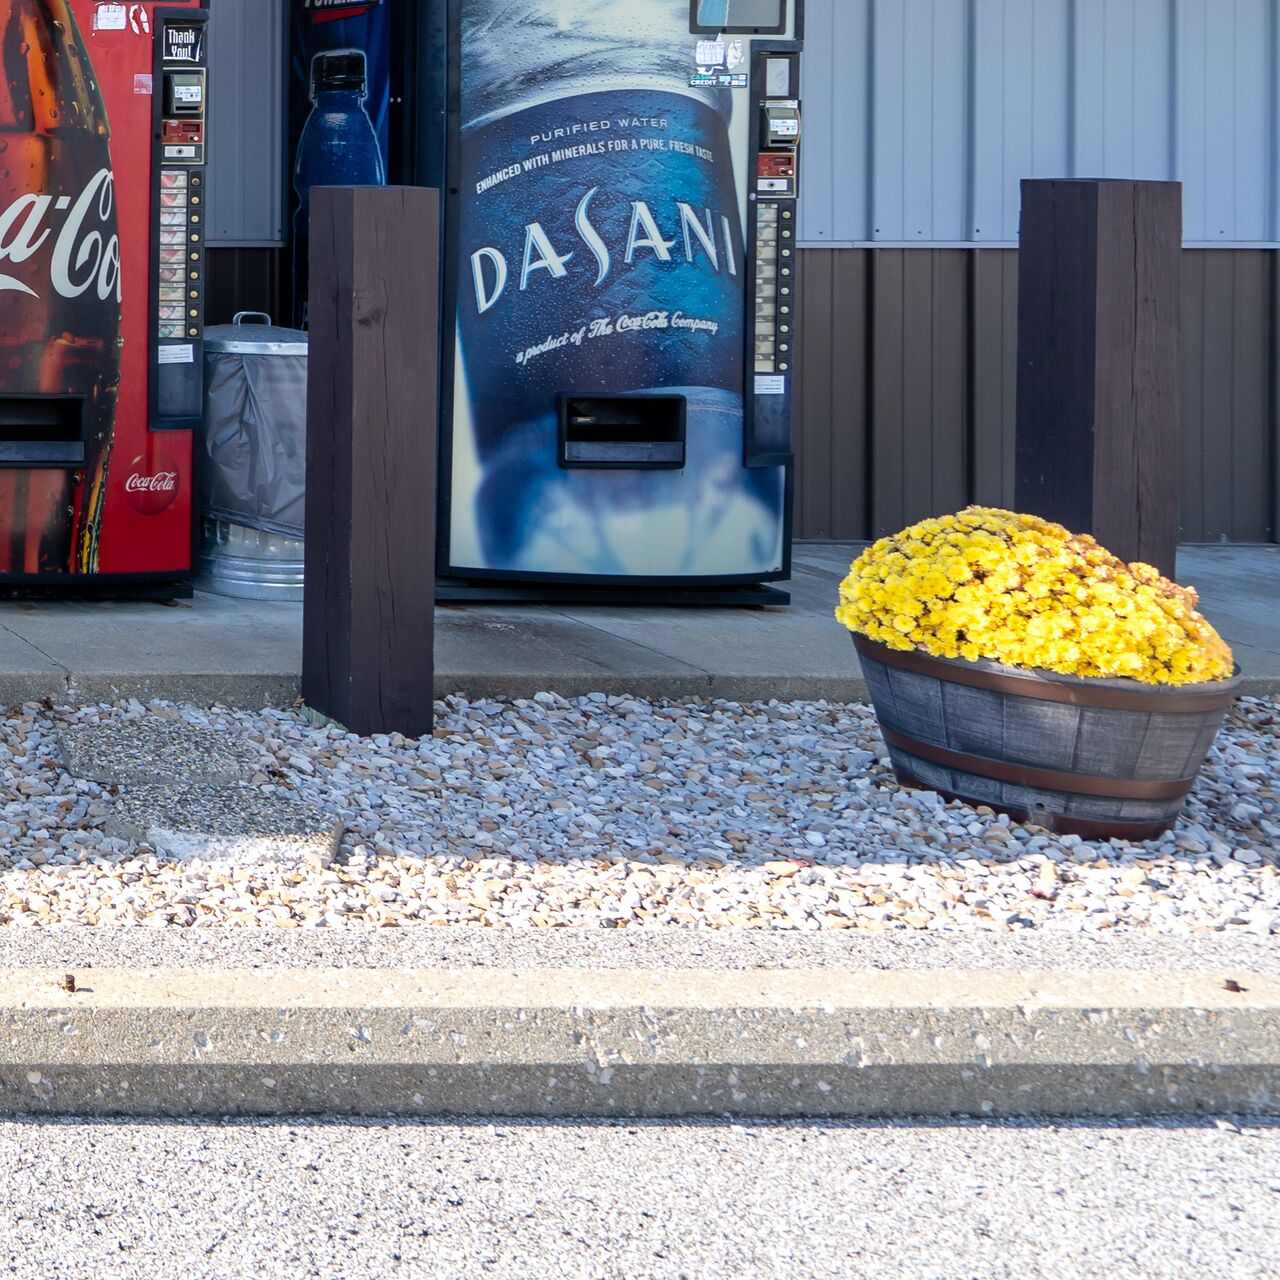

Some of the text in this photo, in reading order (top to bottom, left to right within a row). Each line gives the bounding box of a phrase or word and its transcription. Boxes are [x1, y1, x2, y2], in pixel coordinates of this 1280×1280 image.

[168, 29, 195, 44] Thank
[171, 45, 191, 58] You!
[530, 118, 668, 145] PURIFIED WATER
[476, 163, 522, 195] ENHANCED
[523, 154, 550, 172] WITH
[552, 140, 606, 163] MINERALS
[608, 140, 628, 152] FOR
[631, 139, 639, 150] A
[669, 140, 695, 155] FRESH
[470, 186, 736, 314] DASANI
[516, 311, 719, 365] a product of The Coca-Cola Company
[126, 472, 176, 492] Coca-Cola
